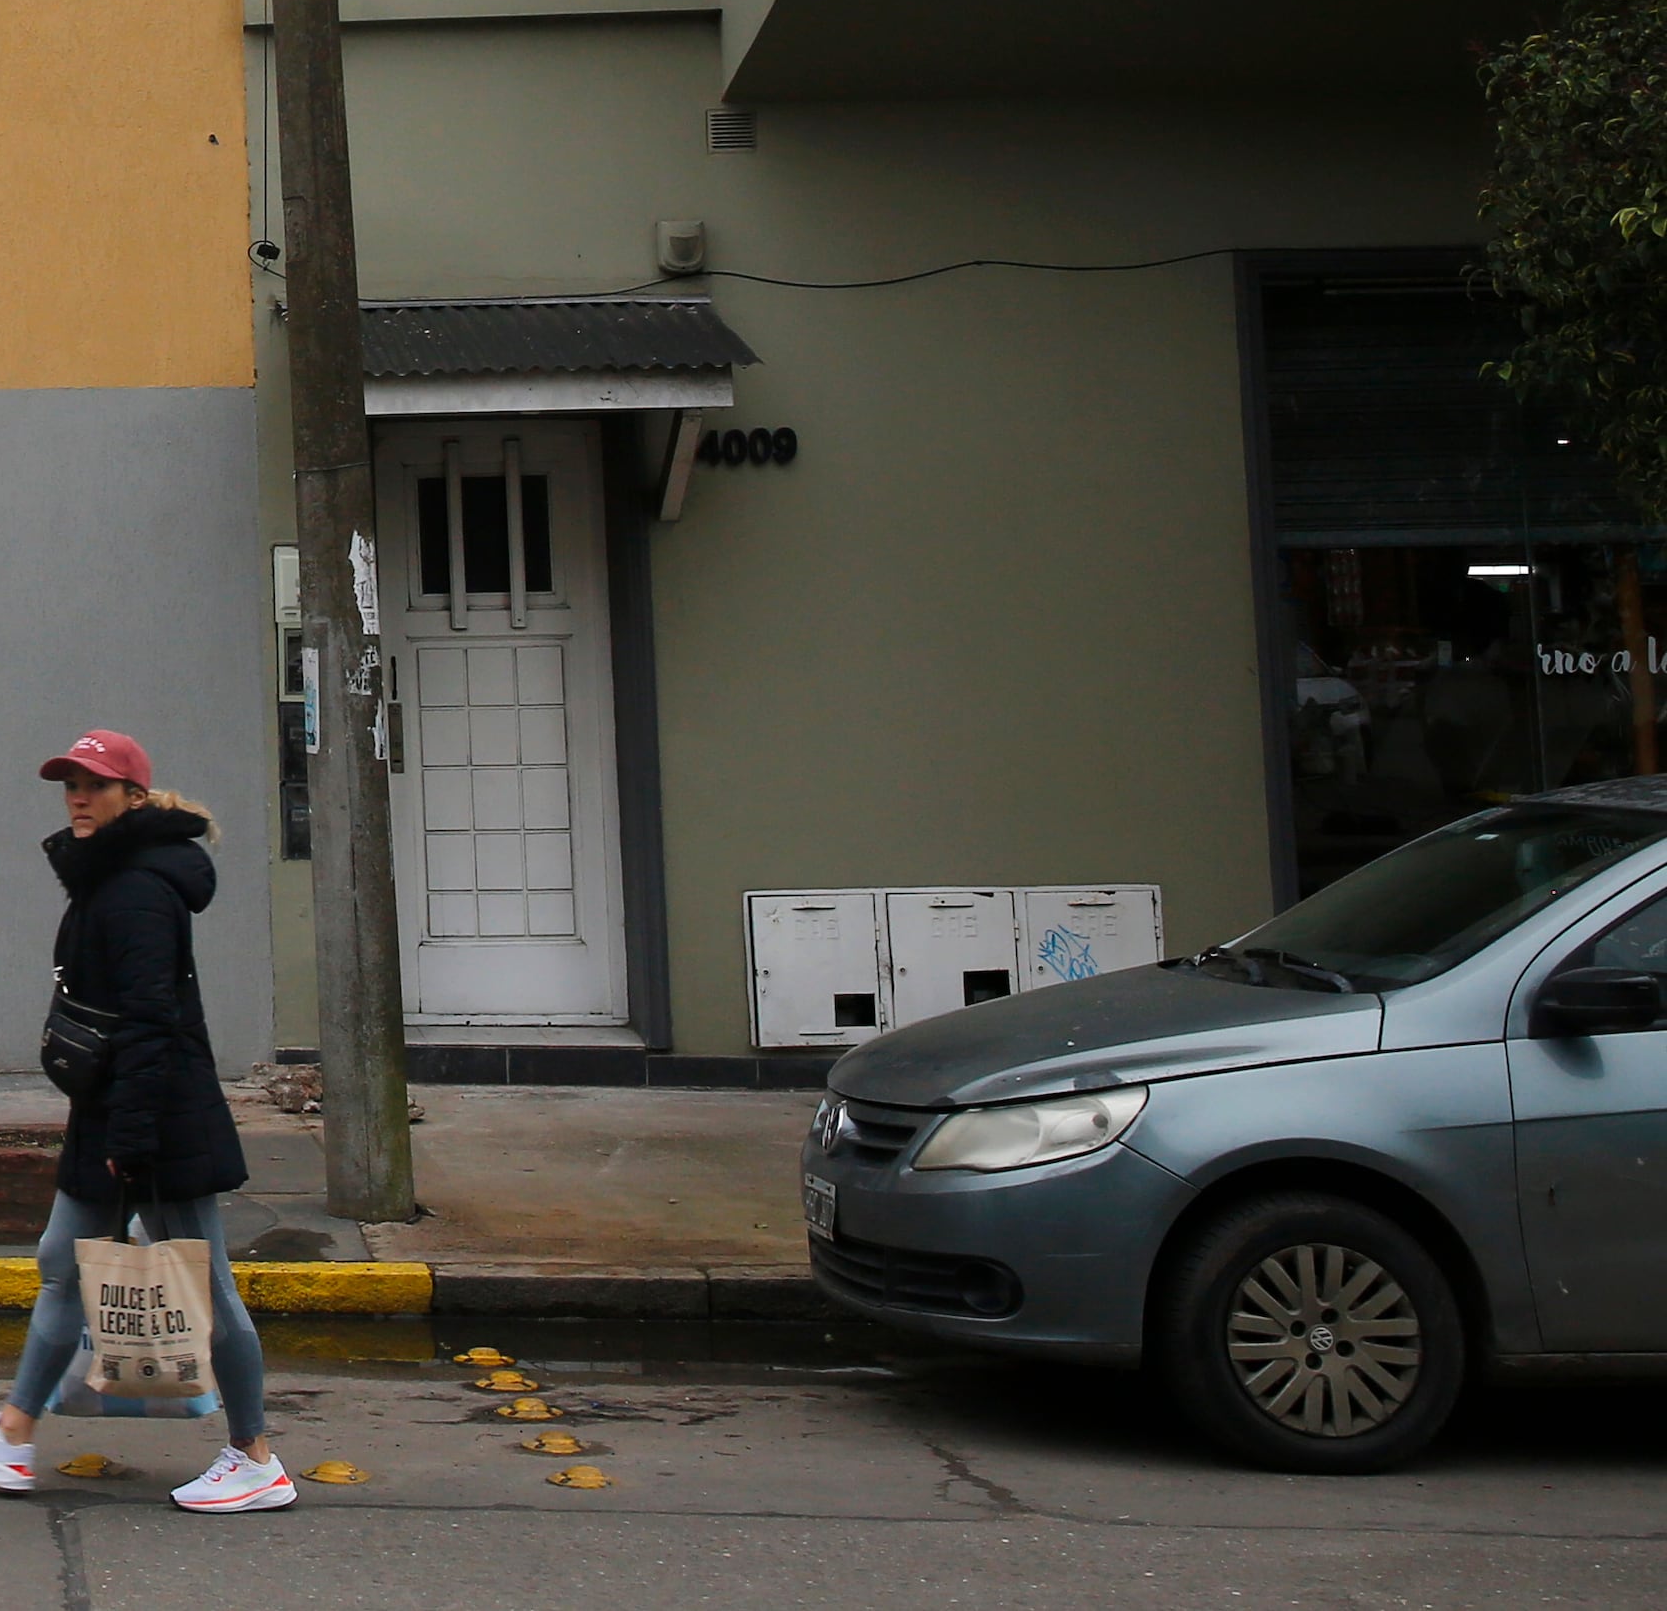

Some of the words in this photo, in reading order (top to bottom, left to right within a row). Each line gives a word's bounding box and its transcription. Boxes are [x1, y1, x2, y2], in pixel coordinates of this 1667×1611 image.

[696, 427, 798, 466] 4009
[100, 1283, 146, 1311] DULCE
[99, 1310, 146, 1337] LECHE
[151, 1314, 162, 1336] &
[165, 1309, 192, 1335] CO.
